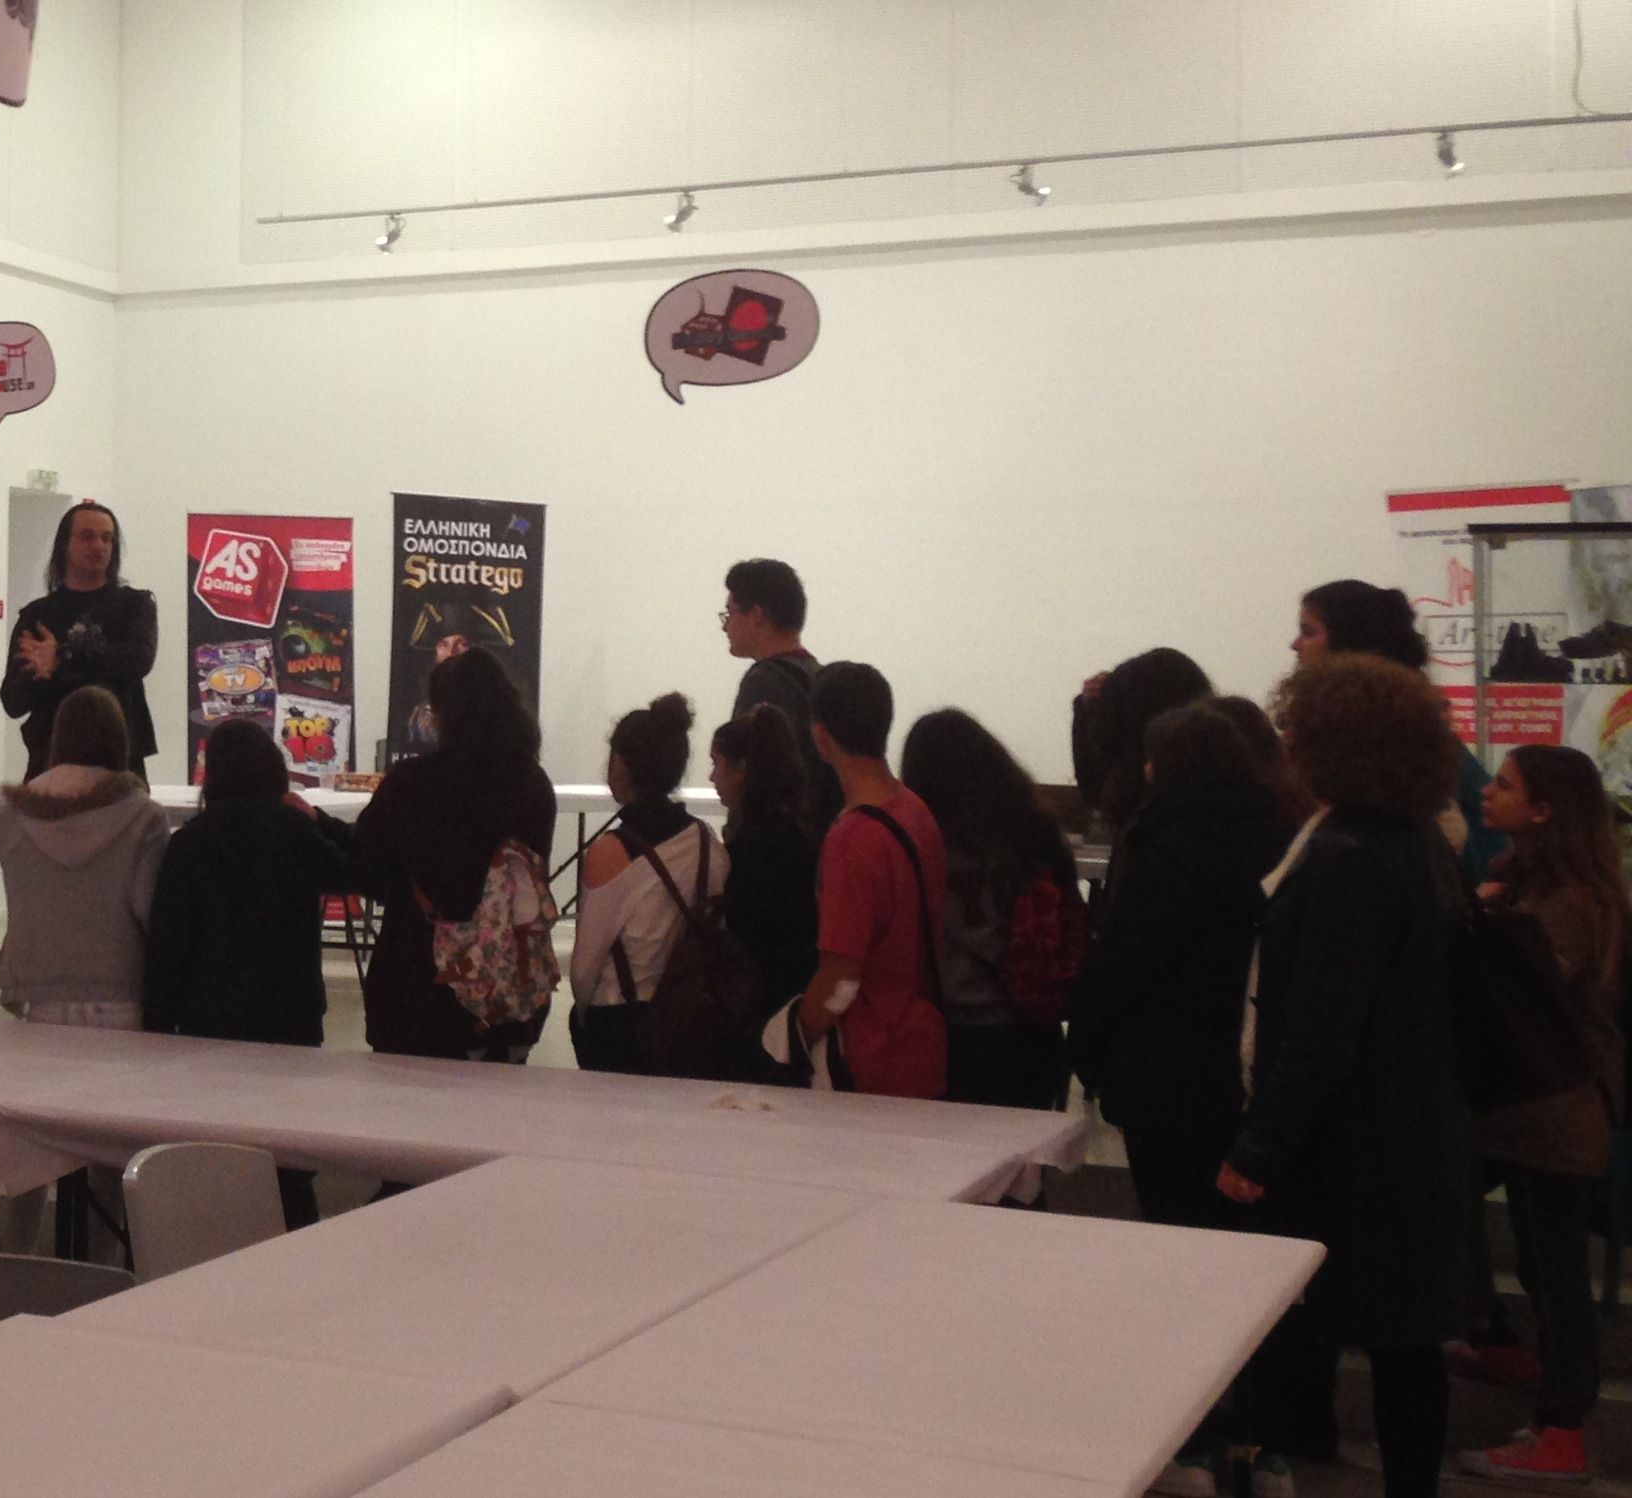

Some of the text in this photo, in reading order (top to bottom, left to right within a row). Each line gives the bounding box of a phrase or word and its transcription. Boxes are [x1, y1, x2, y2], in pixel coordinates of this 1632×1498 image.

[404, 518, 491, 539] ΕΛΛΗΝΙΚΗ
[204, 539, 262, 581] AS
[403, 537, 528, 560] ΟΜΟΣΠΟΝΔΙΑ
[202, 576, 253, 596] games
[402, 554, 524, 596] Stratego
[223, 674, 247, 687] TV
[284, 715, 330, 738] TOP
[283, 734, 337, 764] 10
